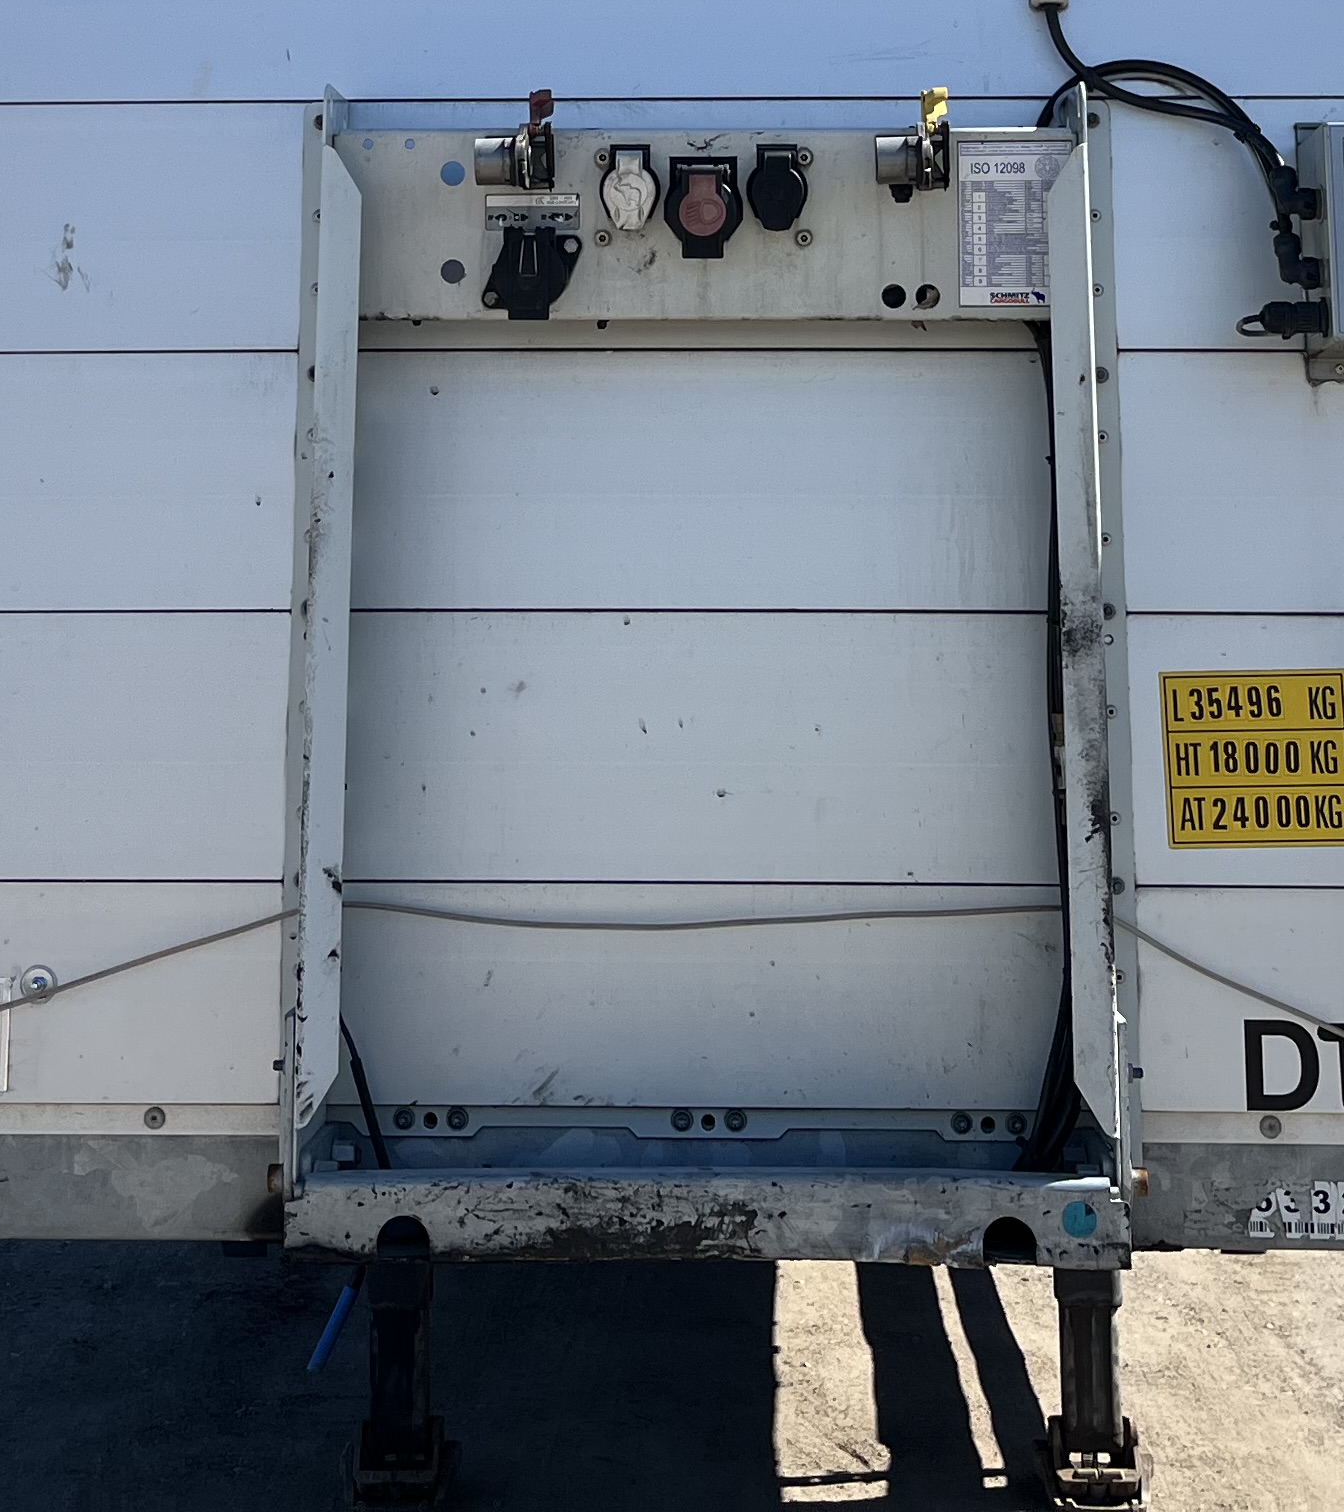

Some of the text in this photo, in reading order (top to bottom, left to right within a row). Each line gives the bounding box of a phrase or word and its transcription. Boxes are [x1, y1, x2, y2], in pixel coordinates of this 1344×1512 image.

[970, 161, 1026, 174] ISO 12098
[989, 291, 1030, 299] SCHMITZ
[1307, 685, 1337, 720] KG
[1309, 739, 1339, 775] KG
